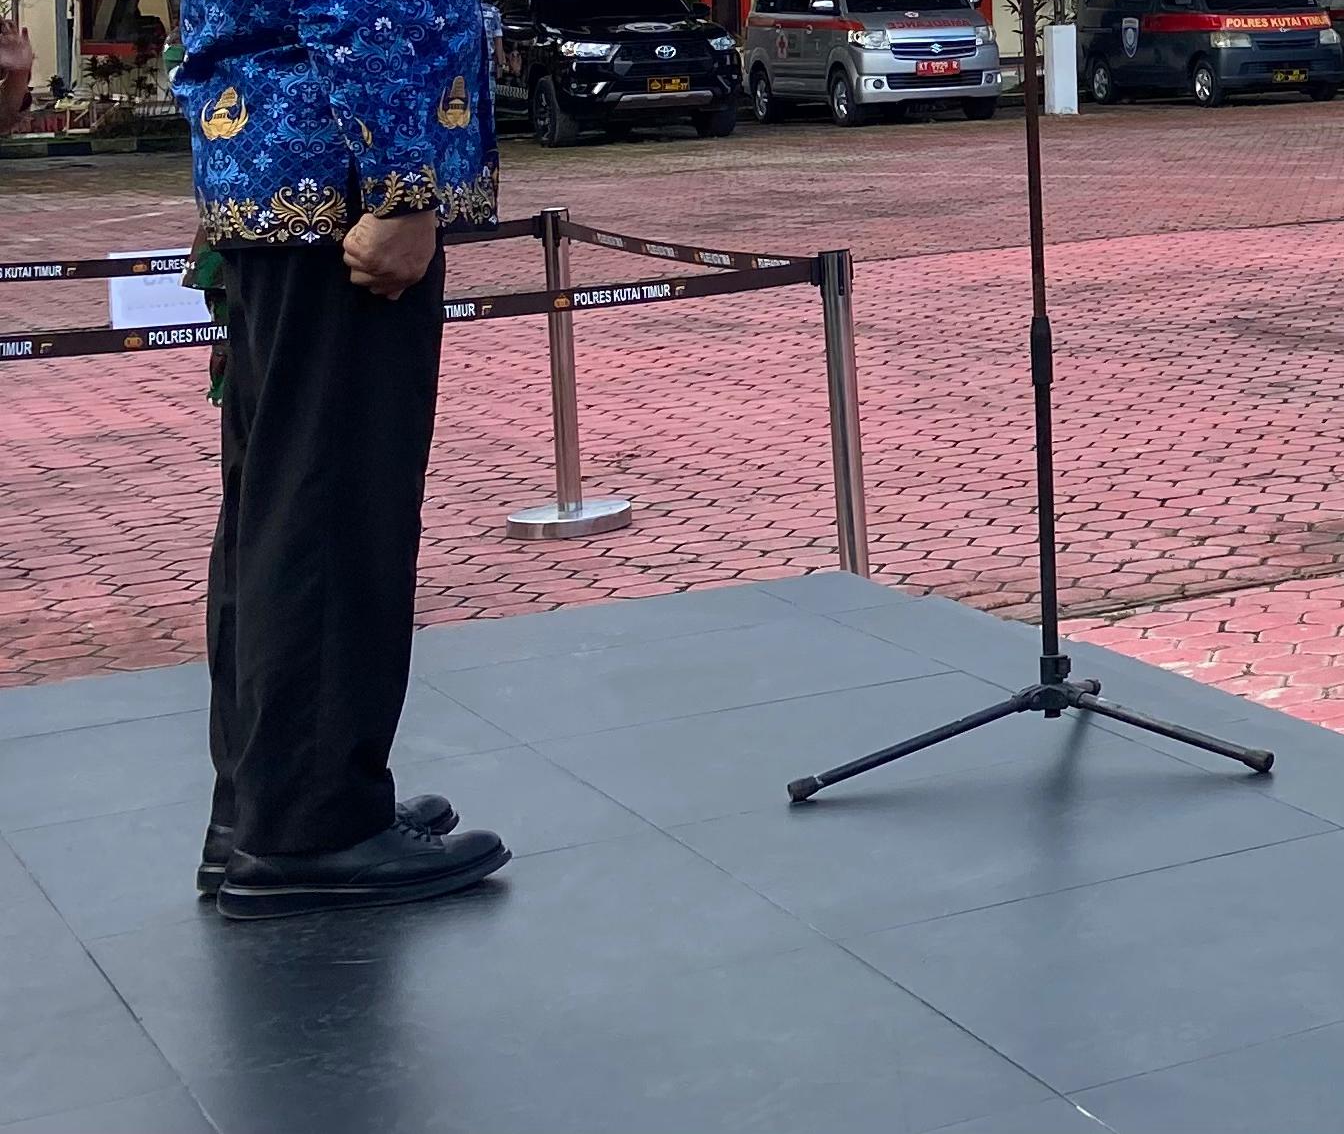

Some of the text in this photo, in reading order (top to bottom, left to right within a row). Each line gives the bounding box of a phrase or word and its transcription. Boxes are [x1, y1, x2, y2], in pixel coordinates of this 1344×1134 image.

[1225, 17, 1269, 28] POLRES
[1271, 17, 1301, 28] KUTAI
[4, 266, 32, 278] KUTAI
[33, 265, 63, 277] TIMUR
[150, 258, 186, 271] POLRES
[573, 284, 671, 306] POLRES KUTAI TIMUR
[443, 303, 476, 319] TIMUR
[148, 325, 229, 346] POLRES KUTAI
